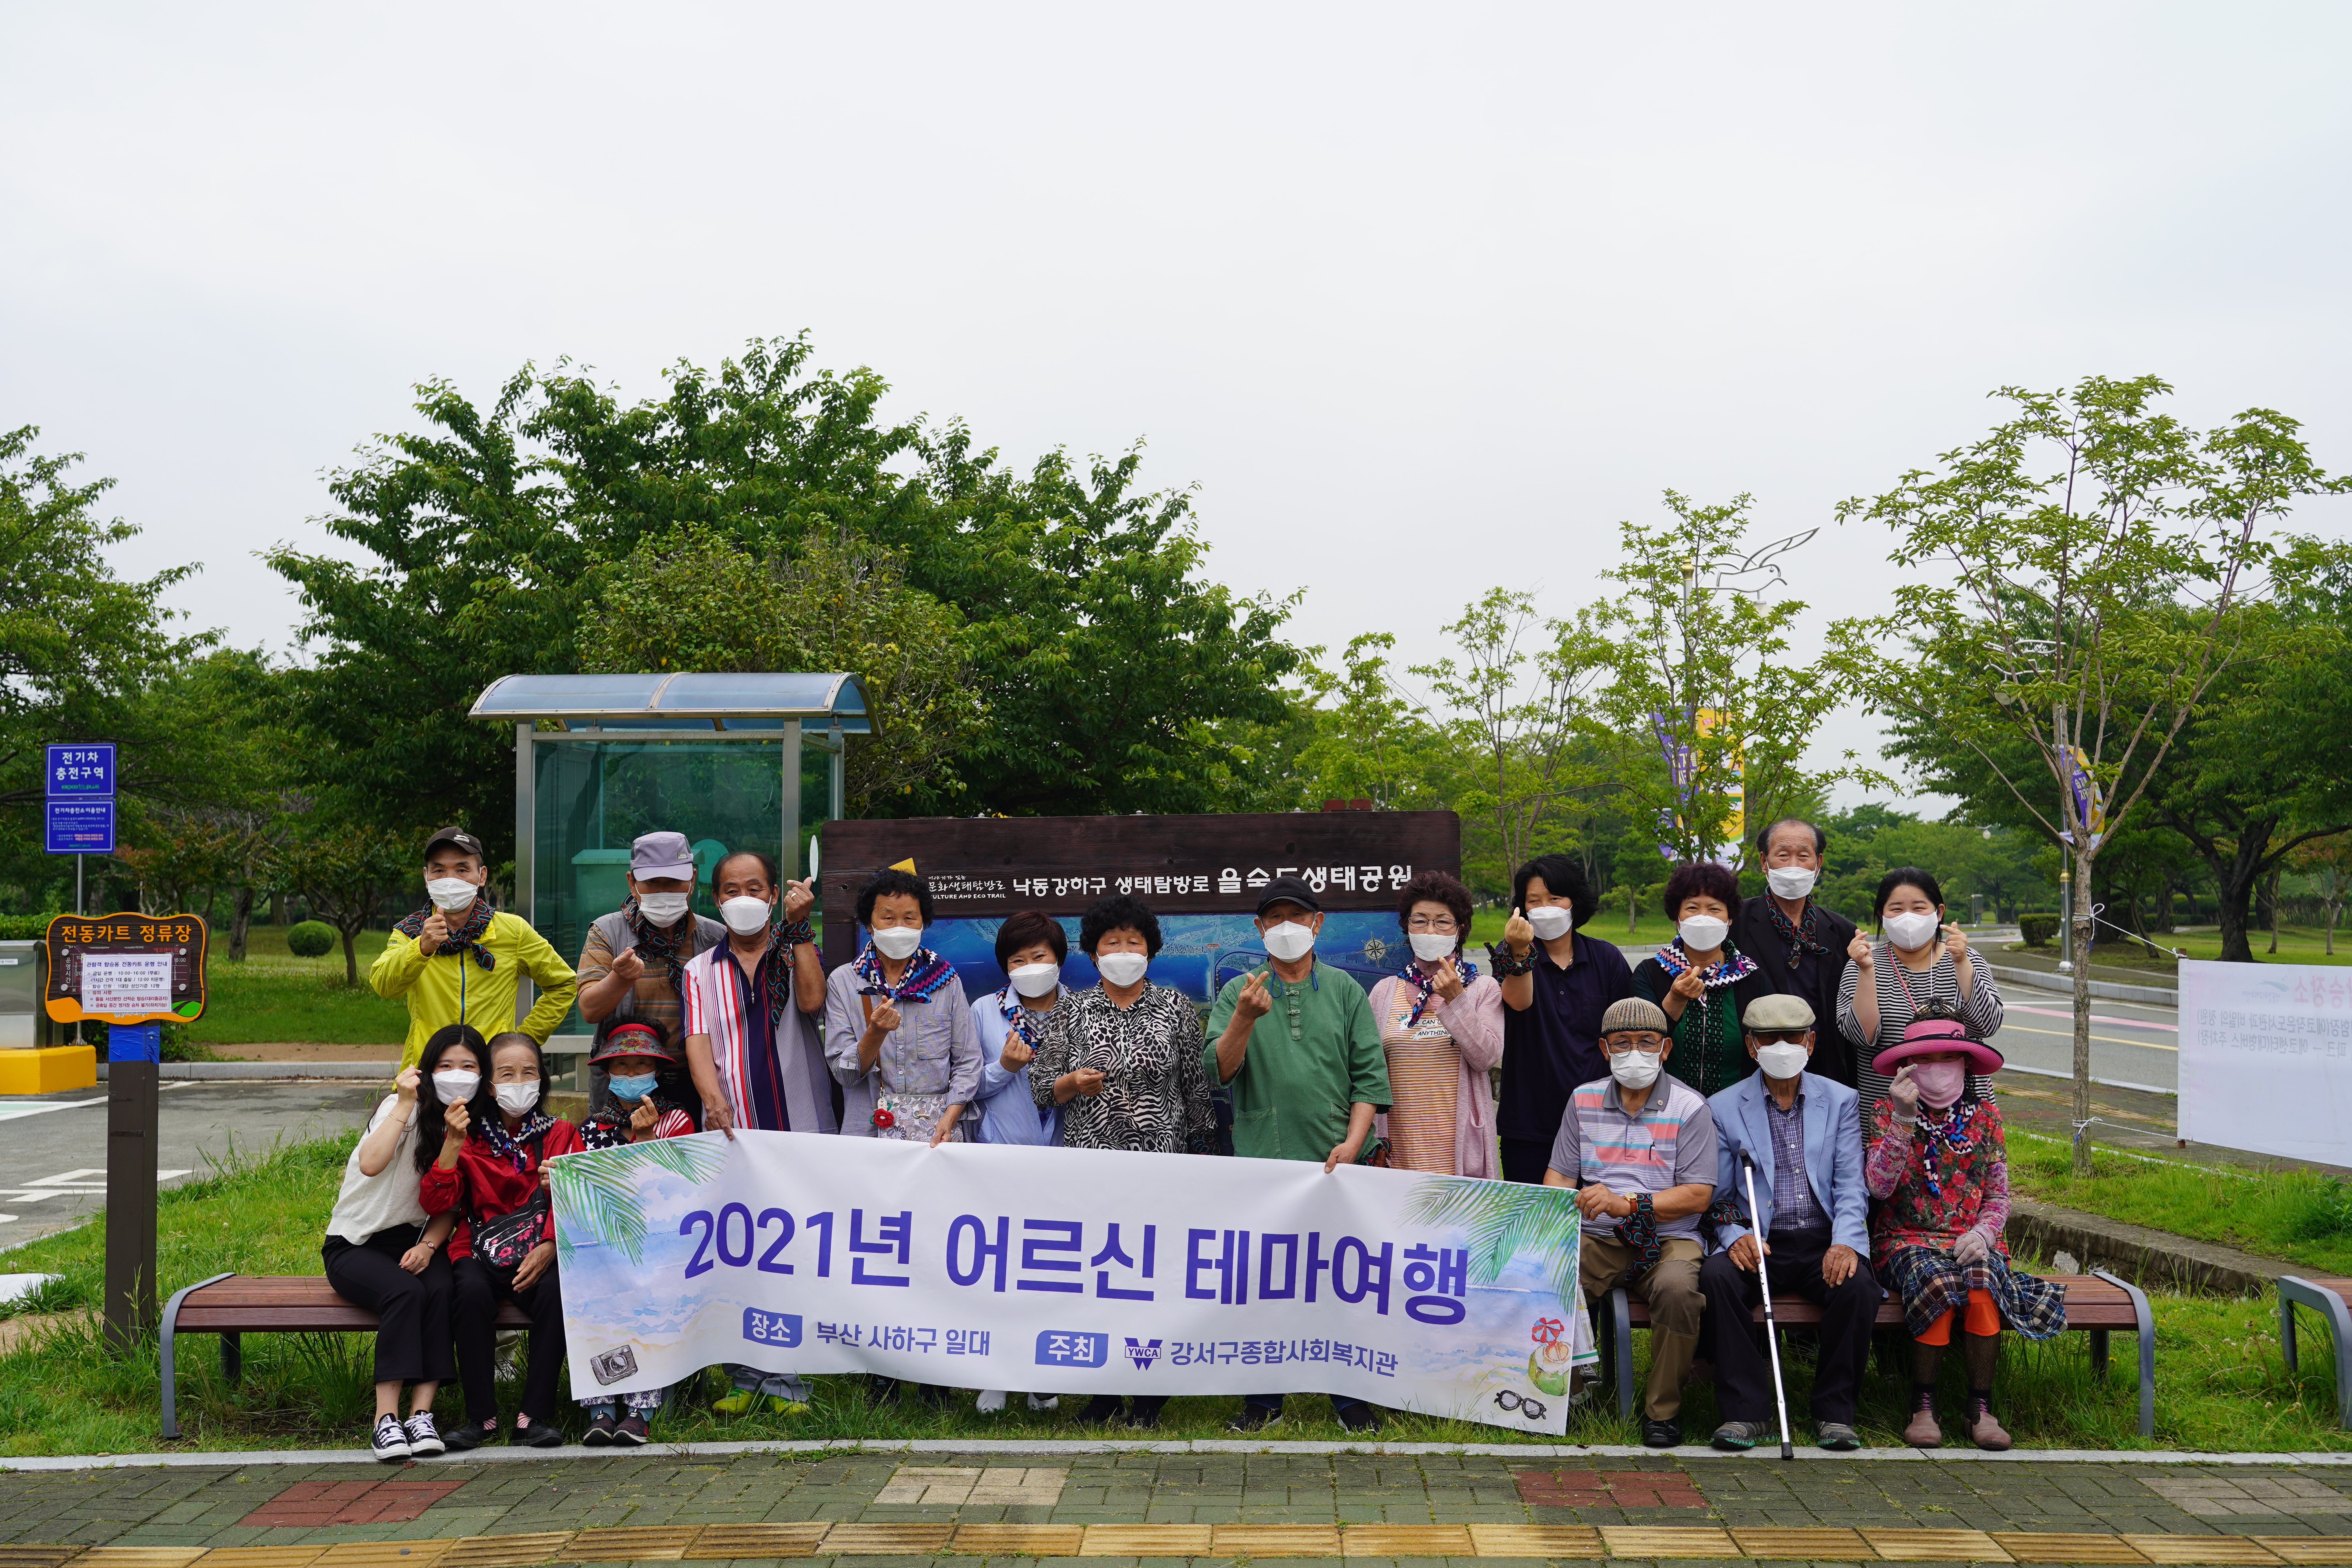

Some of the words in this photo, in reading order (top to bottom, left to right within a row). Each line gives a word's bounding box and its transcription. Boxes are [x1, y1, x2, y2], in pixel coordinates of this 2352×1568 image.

[62, 751, 98, 765] 전기차
[56, 766, 103, 780] 충전구역
[929, 880, 1006, 892] 문화생태탐방로
[1013, 877, 1106, 897] 낙동강하구
[1114, 875, 1209, 895] 생태탐방로
[61, 925, 131, 943] 전동카트
[140, 924, 192, 943] 정류장
[679, 1202, 912, 1287] 2021년
[946, 1214, 1156, 1301] 어르신
[1185, 1228, 1468, 1325] 테마여행
[749, 1312, 791, 1342] 장소
[817, 1321, 862, 1347] 부산
[867, 1325, 937, 1354] 사하구
[946, 1328, 990, 1356] 일대
[1048, 1335, 1094, 1363] 주최
[1128, 1348, 1158, 1357] YWCA
[1171, 1338, 1398, 1377] 강서구종합사회복지관
